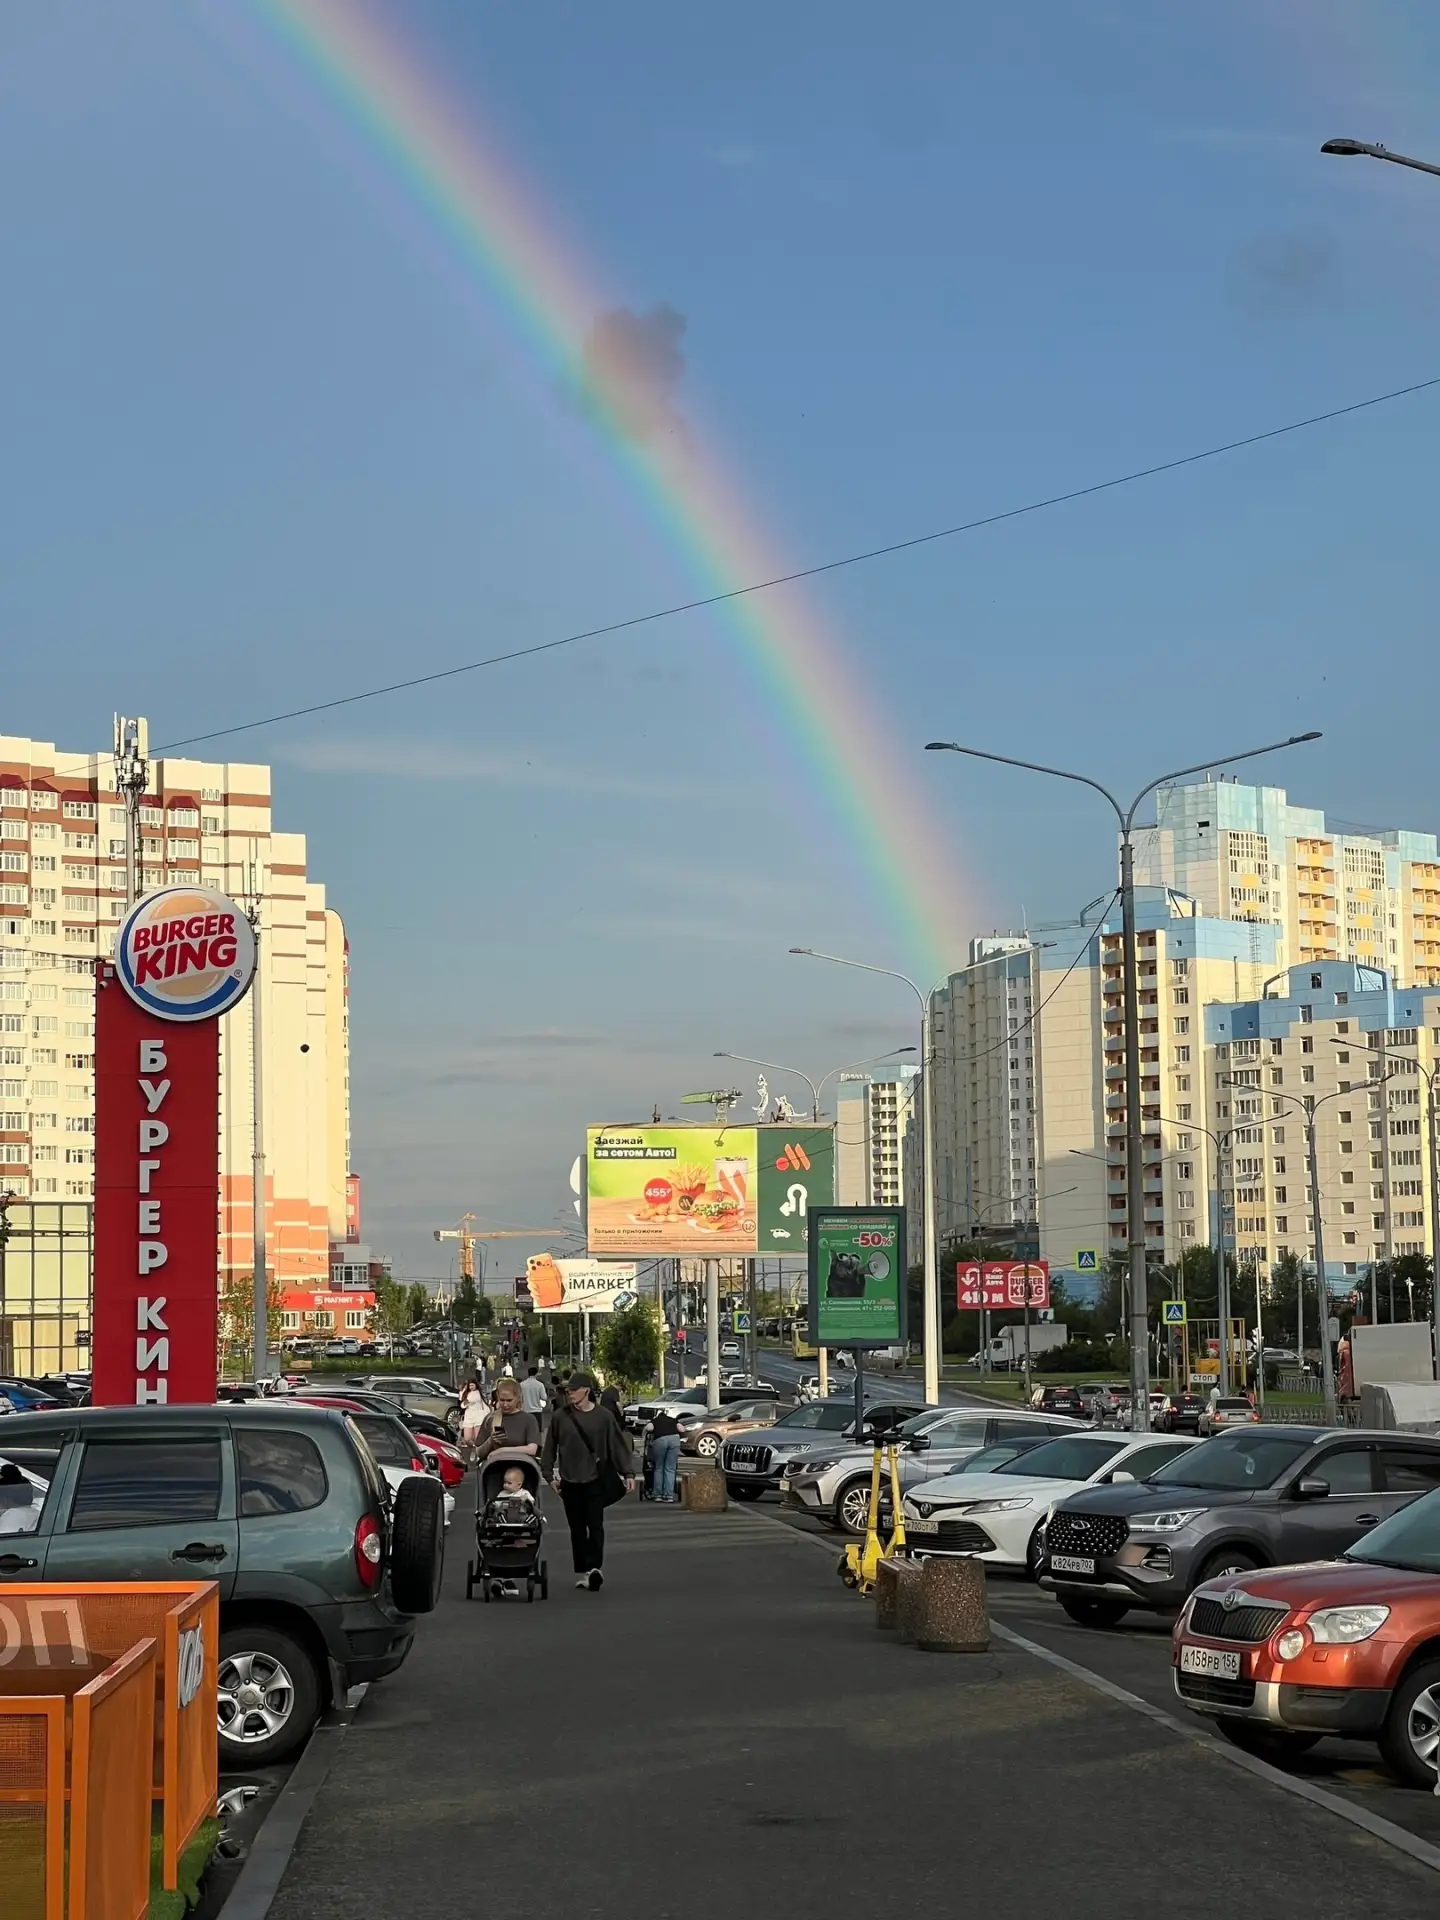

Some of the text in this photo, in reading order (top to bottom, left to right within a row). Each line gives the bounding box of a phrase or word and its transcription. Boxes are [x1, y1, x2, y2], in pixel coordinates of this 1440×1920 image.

[133, 914, 235, 953] BURGER
[134, 936, 238, 987] KING
[594, 1136, 643, 1145] Заезжай
[139, 1039, 171, 1275] БУРГЕР
[596, 1148, 675, 1157] за сетом Авто!
[568, 1278, 633, 1290] iMARKET
[1010, 1285, 1043, 1296] KIG
[324, 1296, 353, 1304] МАГНИТ
[961, 1290, 989, 1304] 410
